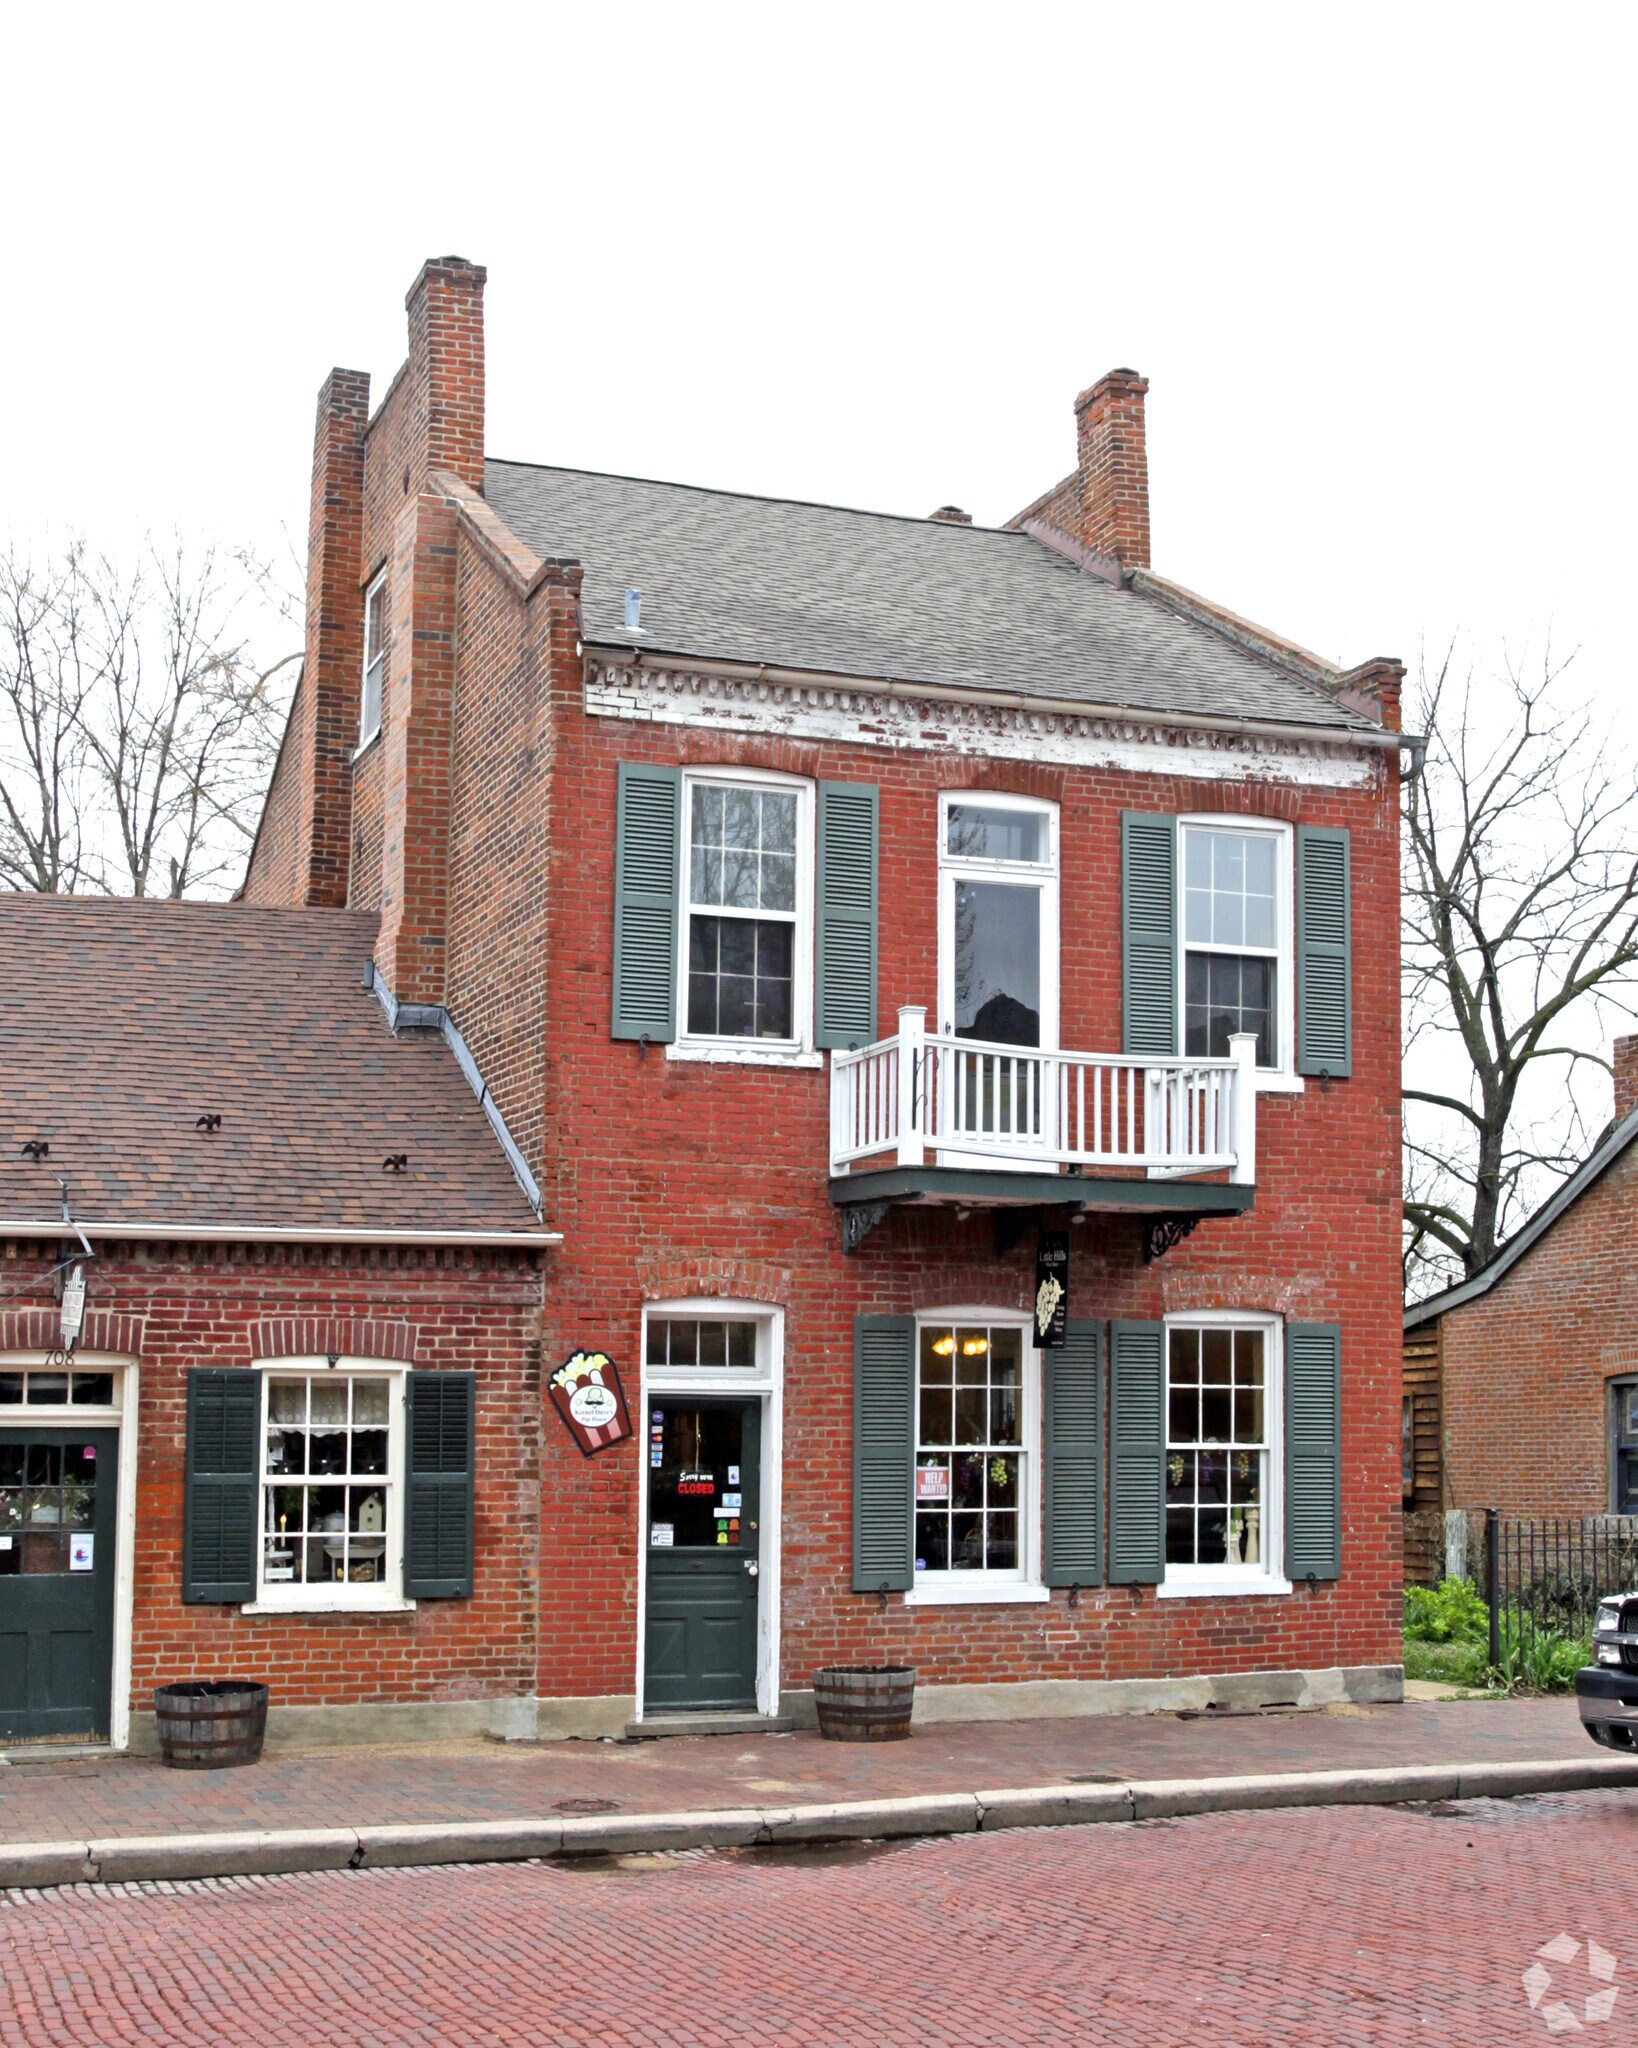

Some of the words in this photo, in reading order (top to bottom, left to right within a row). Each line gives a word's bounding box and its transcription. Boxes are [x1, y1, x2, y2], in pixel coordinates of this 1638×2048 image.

[1053, 1250, 1067, 1261] Hills
[45, 1350, 75, 1366] 708
[924, 1471, 944, 1484] HELP
[678, 1483, 715, 1494] CLOSED
[920, 1484, 948, 1495] WANTED
